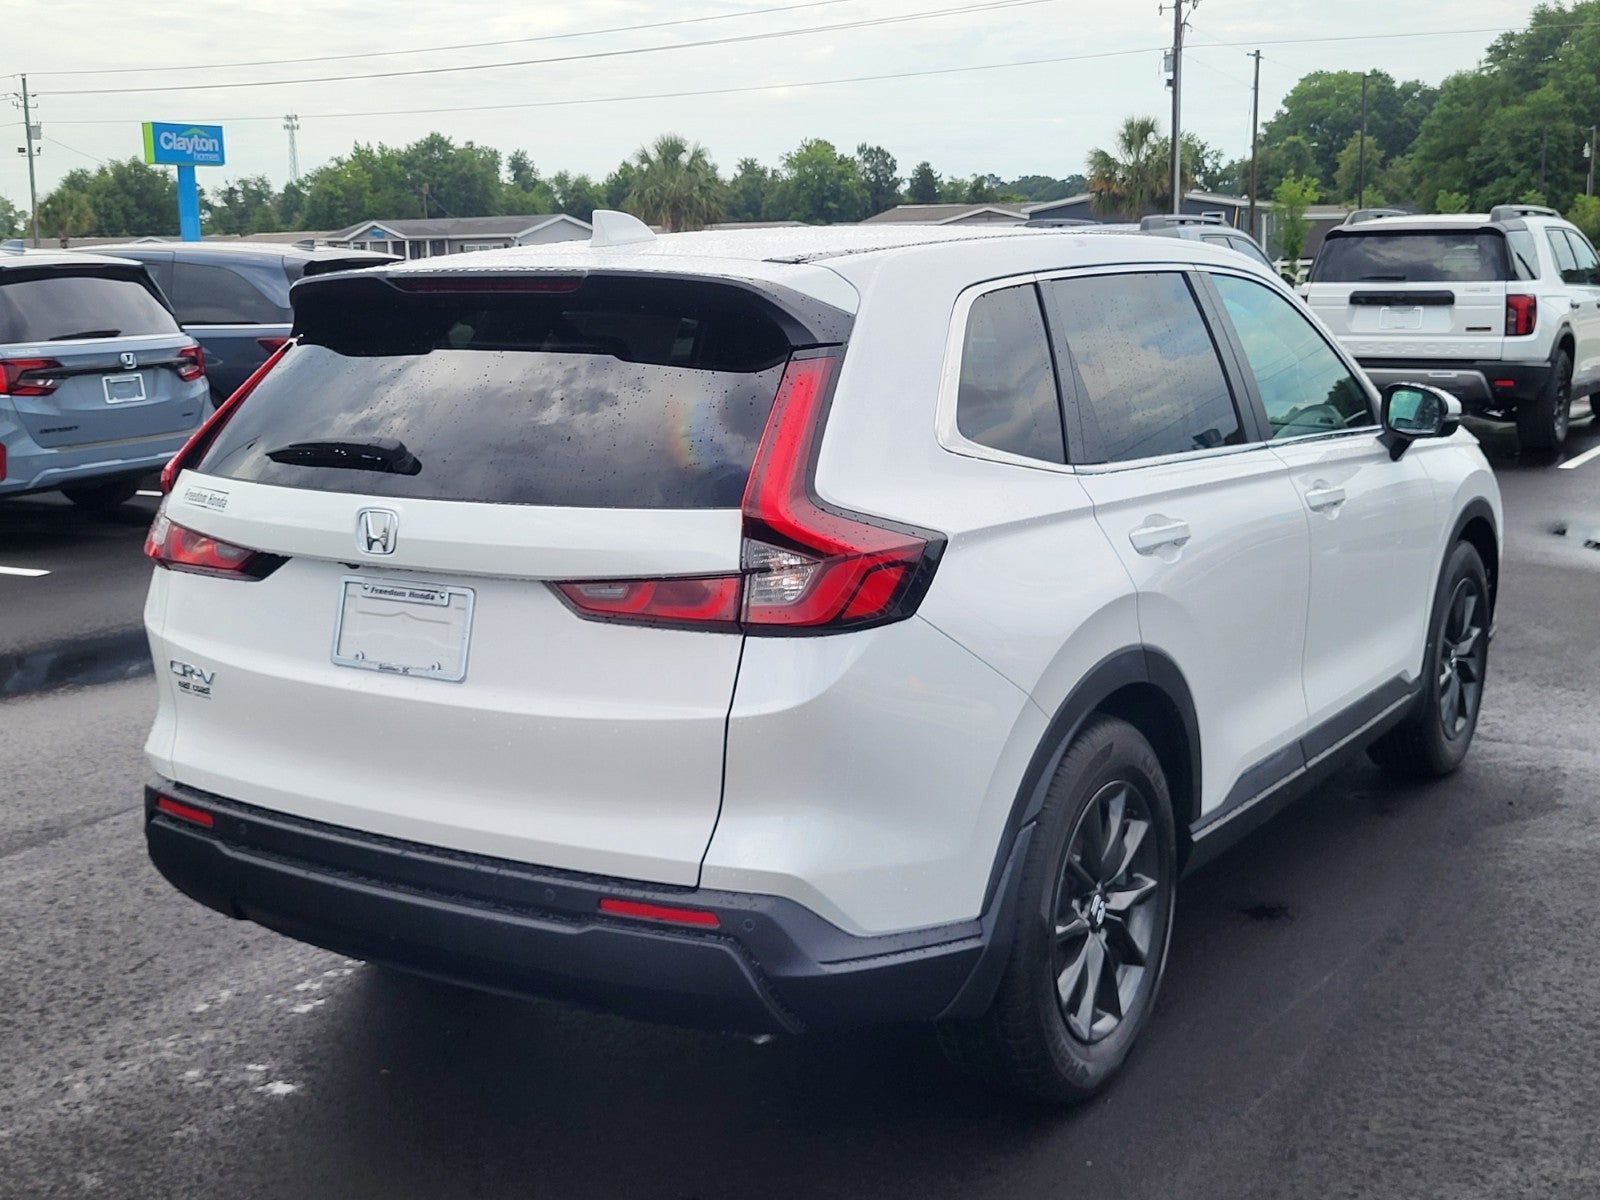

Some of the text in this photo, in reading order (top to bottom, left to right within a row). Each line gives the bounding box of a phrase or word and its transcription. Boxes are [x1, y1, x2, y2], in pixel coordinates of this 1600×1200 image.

[159, 131, 219, 154] Clayton
[370, 586, 435, 600] Freedom Honda
[170, 660, 215, 685] CR-V
